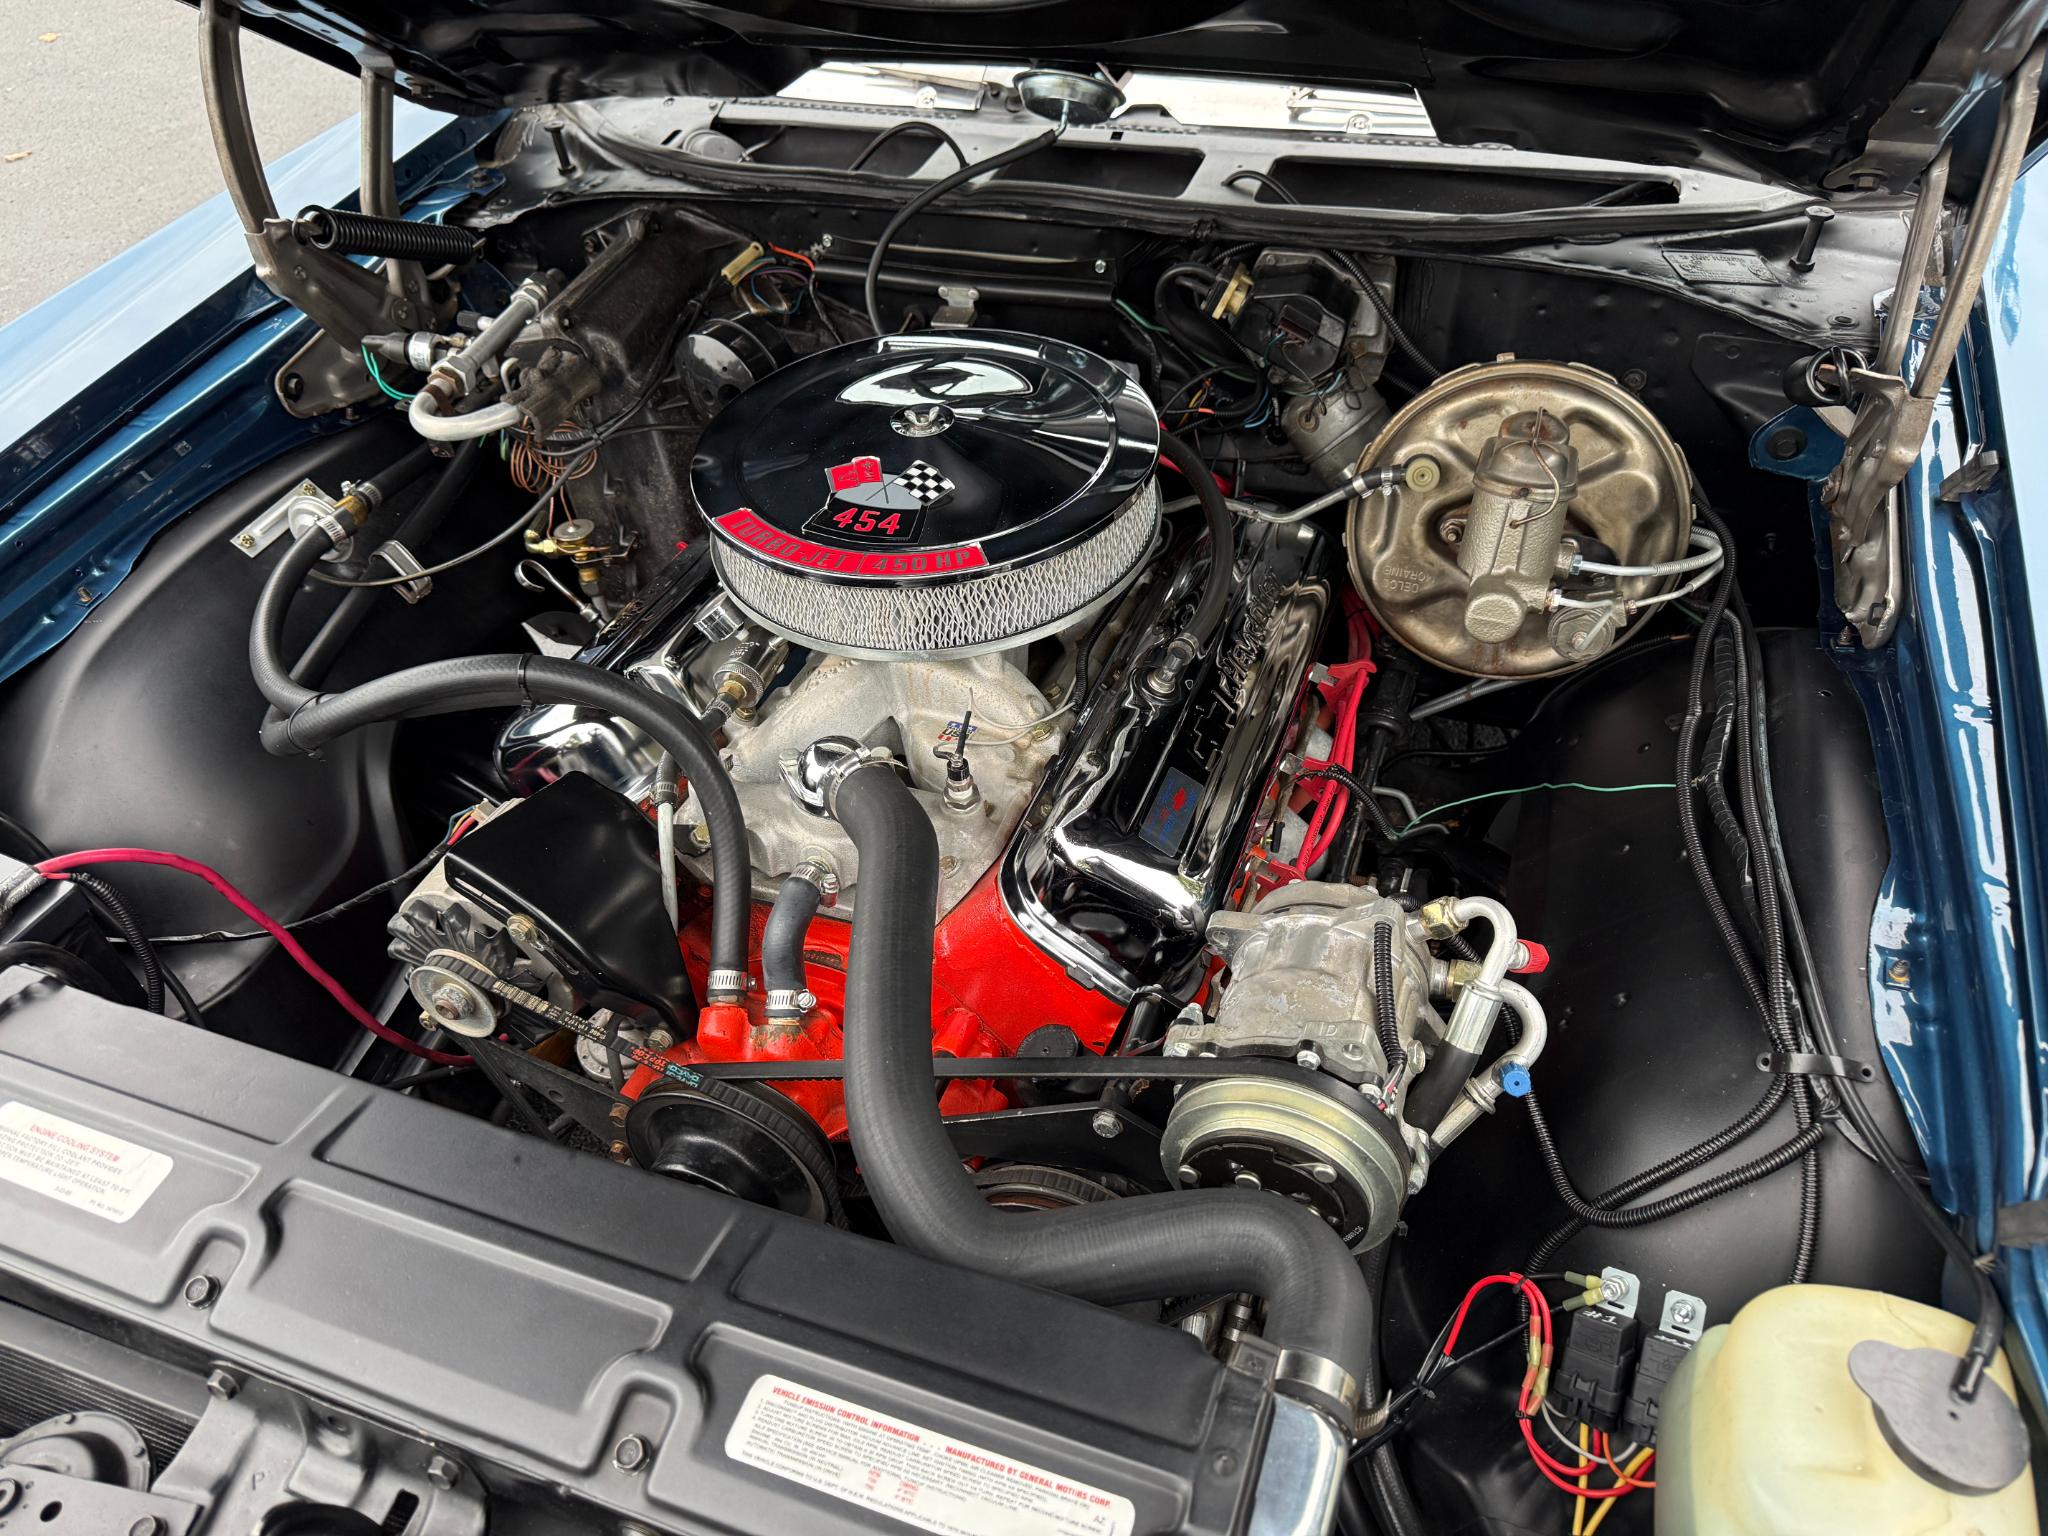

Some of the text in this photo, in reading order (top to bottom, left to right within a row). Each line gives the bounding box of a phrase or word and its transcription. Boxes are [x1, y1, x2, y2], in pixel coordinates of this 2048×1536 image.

[833, 507, 901, 534] 454
[731, 517, 970, 572] TURBO-JET 450 HP
[650, 1057, 667, 1067] TOP
[667, 1064, 700, 1082] DAYCO
[57, 1134, 89, 1150] COOLING
[772, 1387, 800, 1401] VEHICLE
[801, 1397, 835, 1413] EMISSION
[837, 1409, 869, 1425] CONTROL
[870, 1421, 919, 1442] INFORMATION
[945, 1446, 1004, 1471] MANUFACTURED
[1007, 1467, 1017, 1475] BY
[1019, 1471, 1053, 1488] GENERAL
[1055, 1484, 1087, 1499] MOTORS
